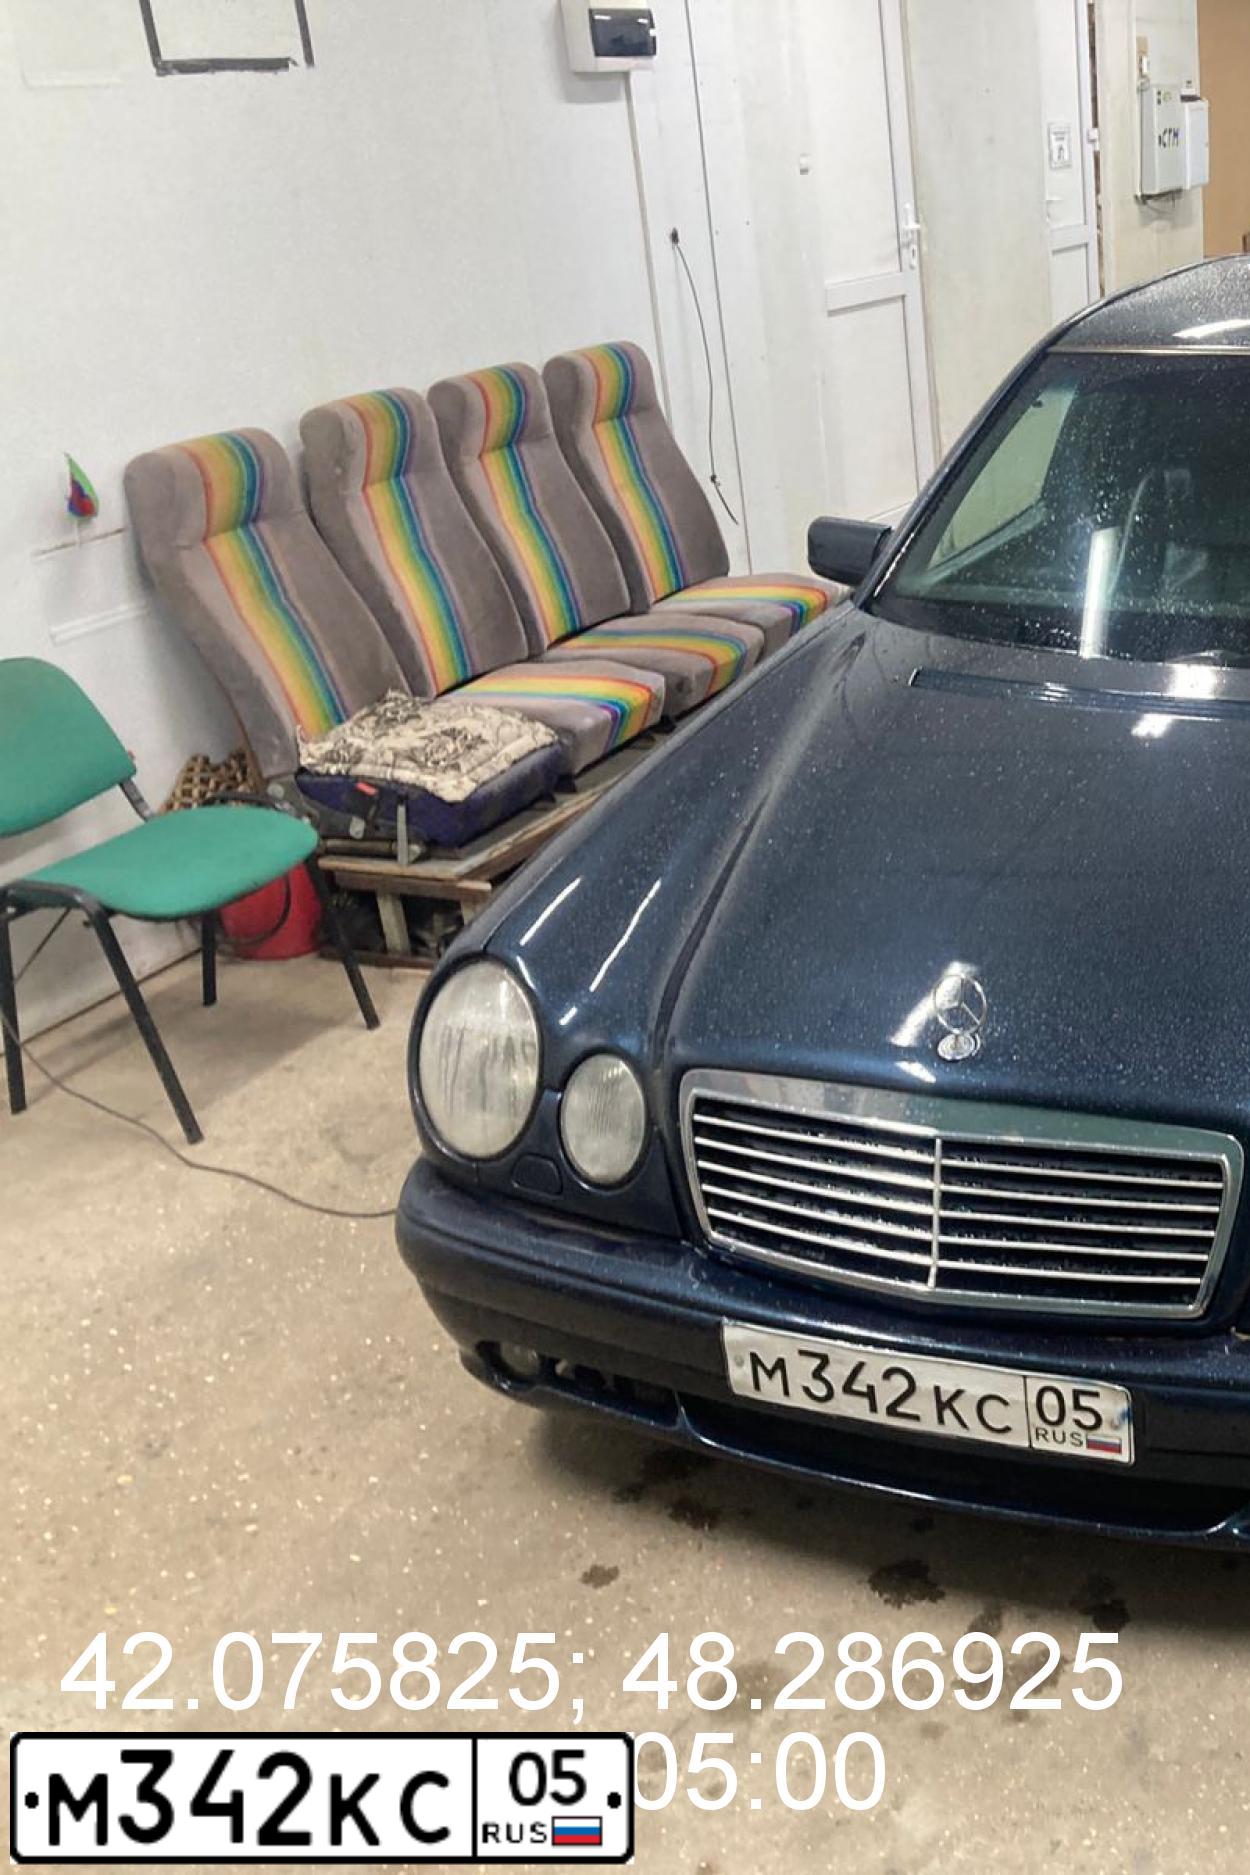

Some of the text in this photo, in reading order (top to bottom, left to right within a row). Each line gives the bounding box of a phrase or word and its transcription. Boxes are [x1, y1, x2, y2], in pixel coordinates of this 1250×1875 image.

[749, 1350, 1102, 1434] М342КС 05
[1034, 1427, 1084, 1448] RUS
